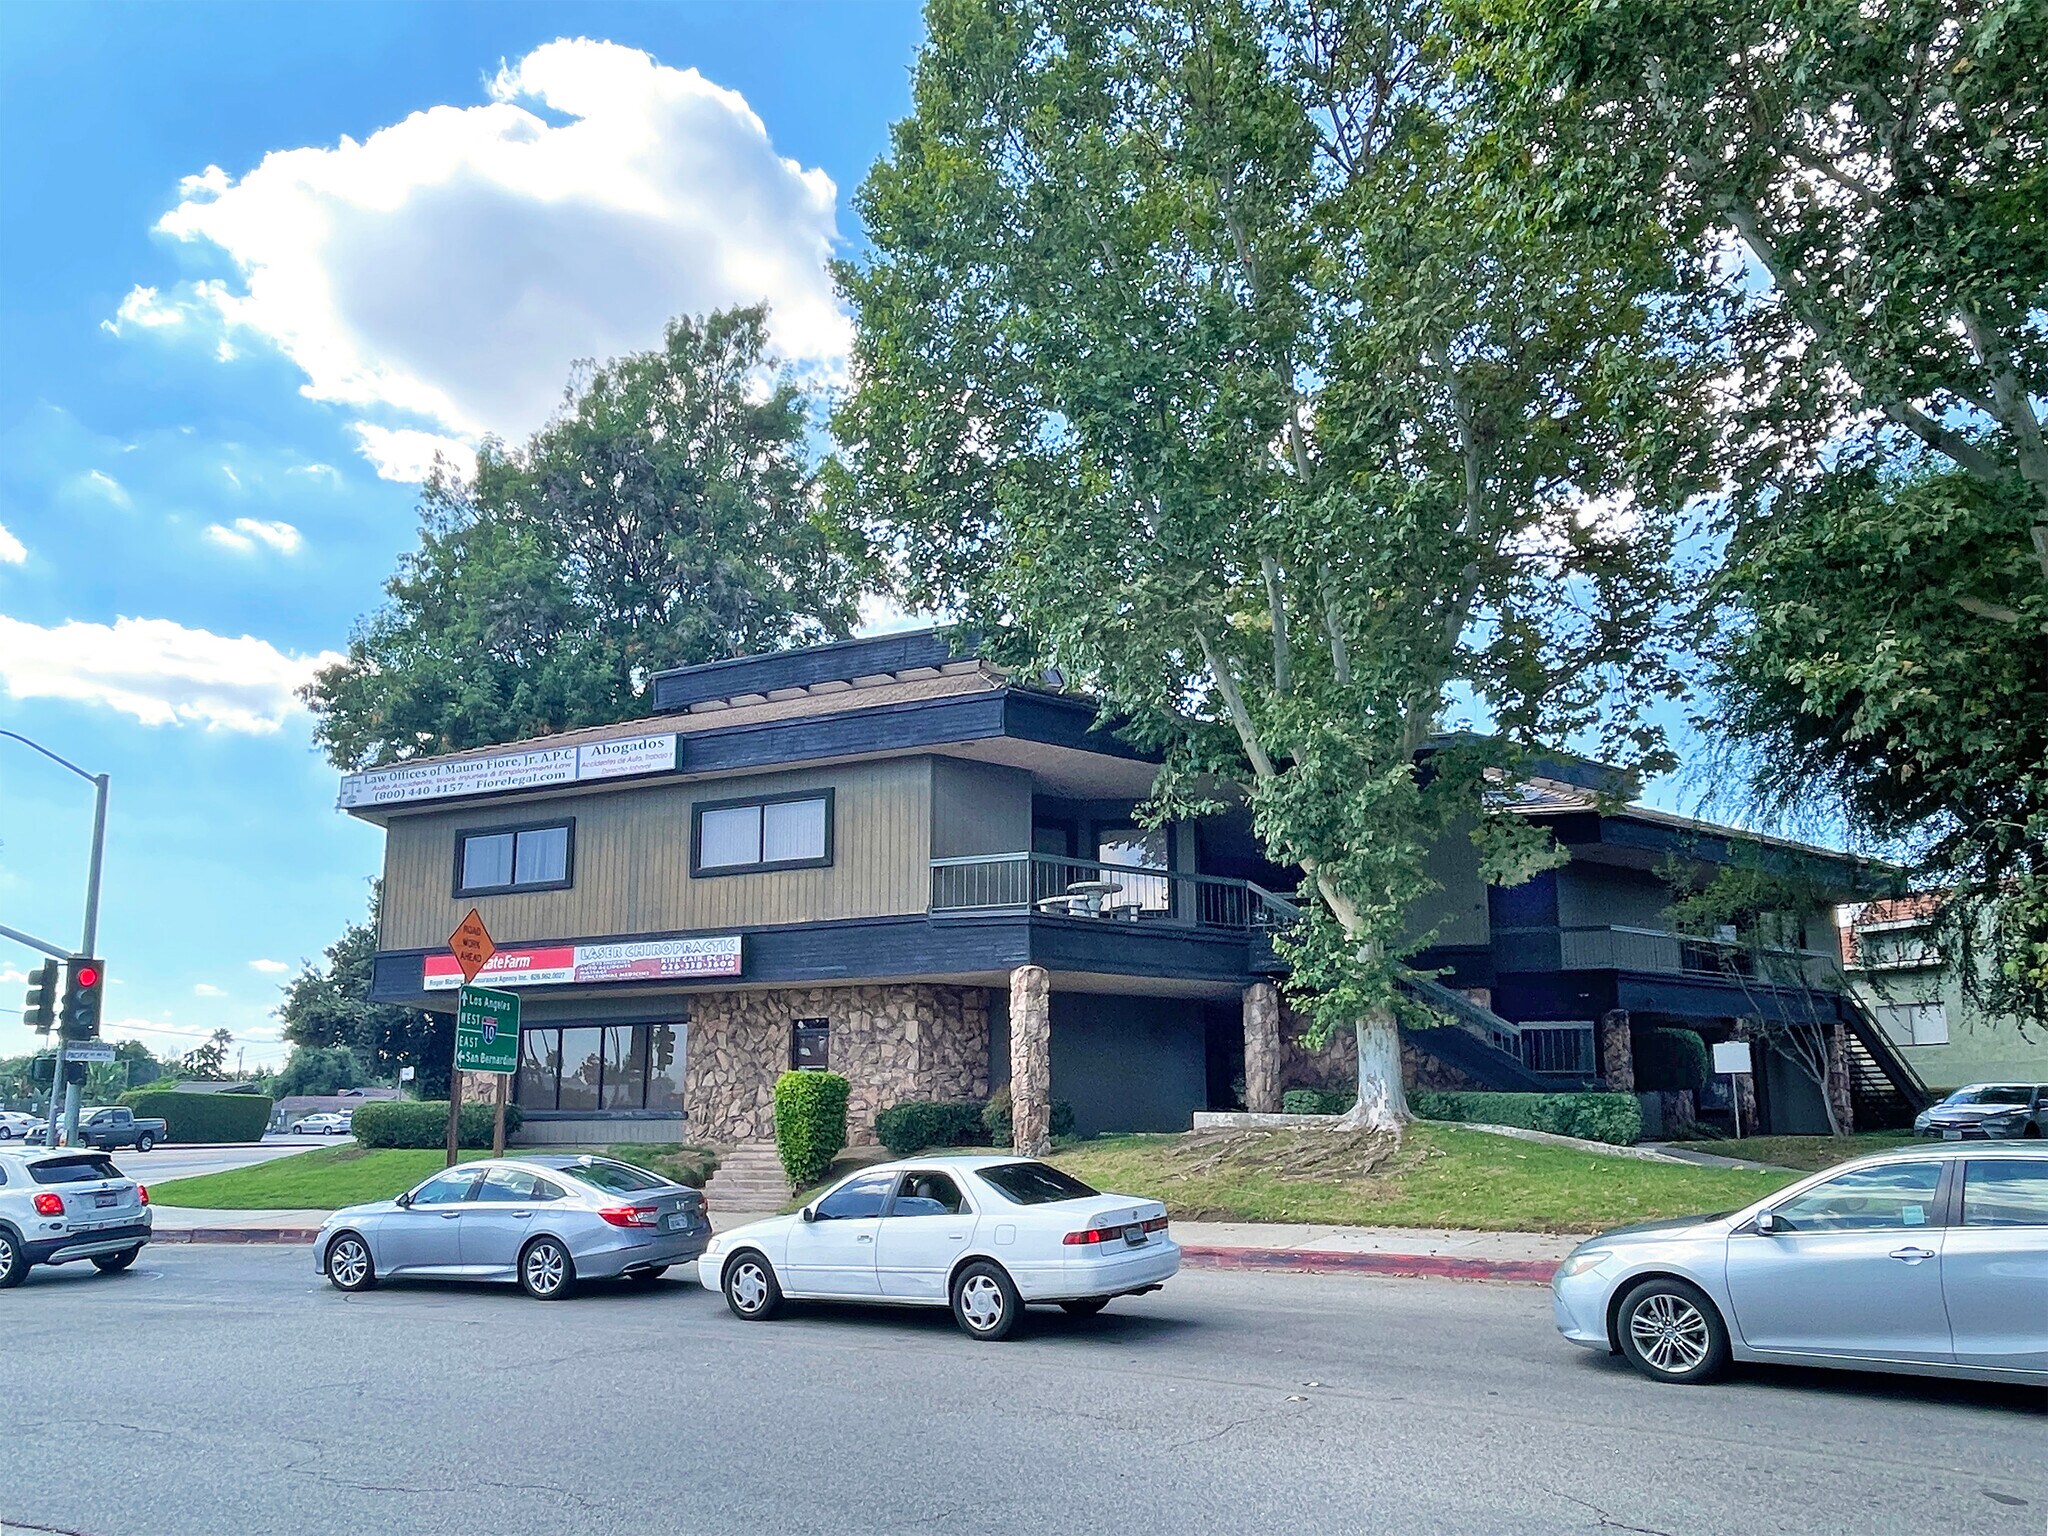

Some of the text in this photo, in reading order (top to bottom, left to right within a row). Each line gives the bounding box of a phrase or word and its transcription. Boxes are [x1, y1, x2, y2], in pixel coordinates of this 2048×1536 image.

[591, 739, 665, 757] Abogados
[364, 749, 574, 785] Law Offices of Mauro Fiore, Jr. A.P.C.
[371, 784, 390, 792] Auto
[459, 771, 488, 781] Injuries
[498, 763, 553, 776] Employment
[554, 761, 572, 769] Law
[476, 771, 566, 789] Fiorelegal.com
[374, 782, 464, 802] (800) 440 4157
[463, 924, 482, 936] ROAD
[462, 938, 480, 949] WORK
[581, 938, 735, 961] LASER CHIROPRACTIC
[460, 951, 482, 963] AHEAD
[474, 975, 497, 983] nsurance
[499, 974, 517, 983] Agency
[469, 994, 511, 1012] Los Angeles
[461, 1012, 480, 1025] WEST
[485, 1026, 495, 1040] 10
[459, 1035, 479, 1048] EAST
[465, 1051, 517, 1066] San Bernardino
